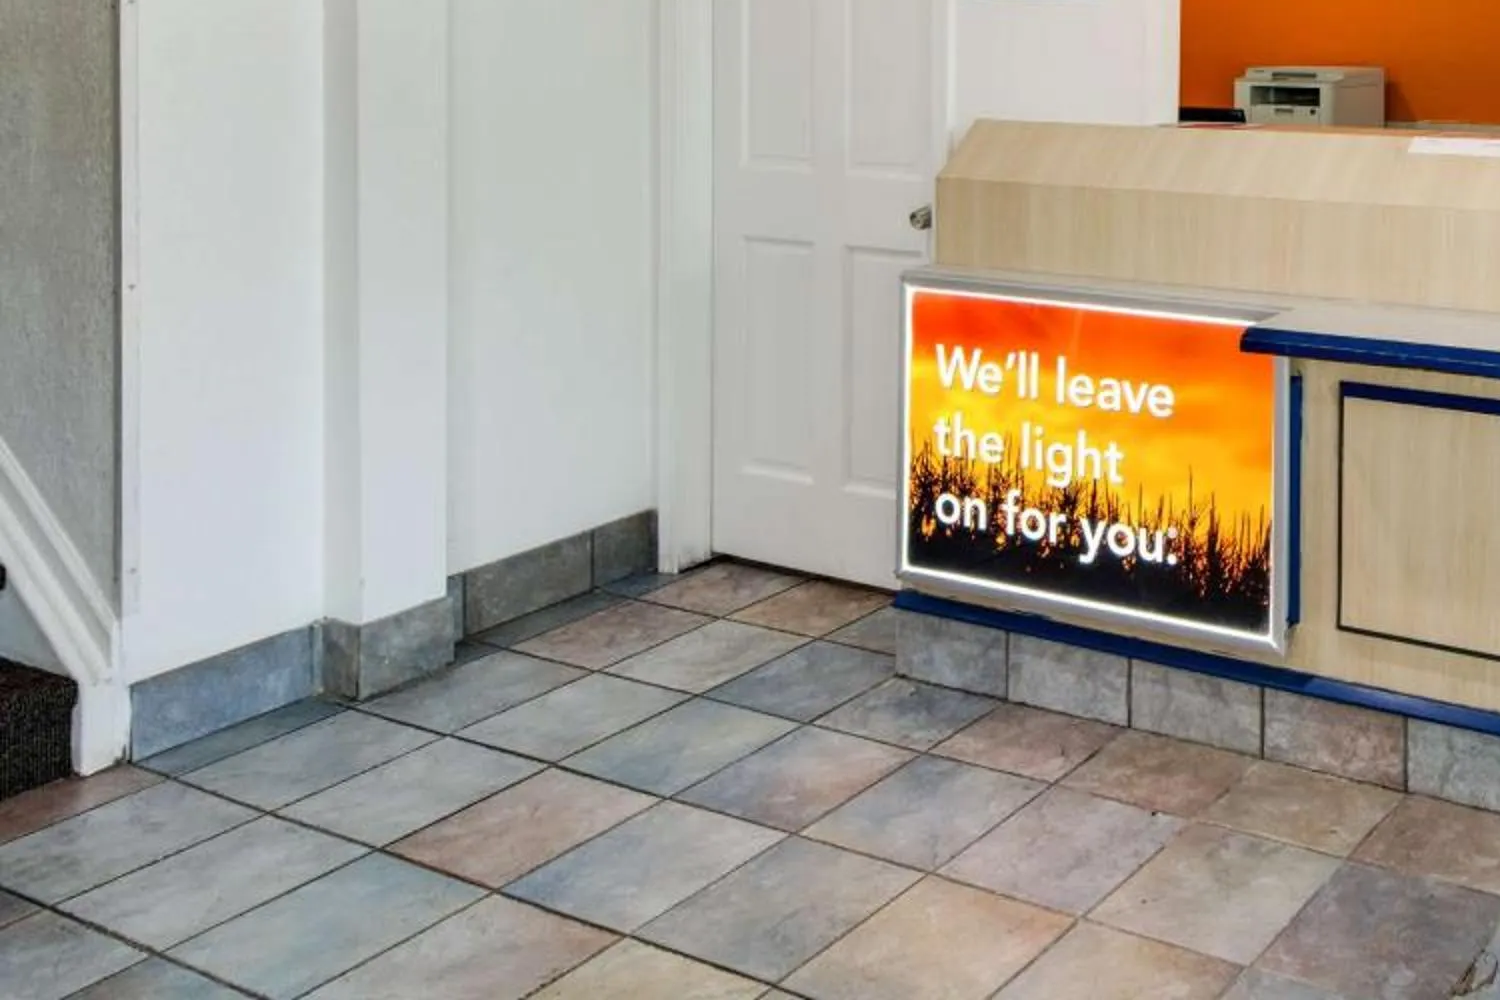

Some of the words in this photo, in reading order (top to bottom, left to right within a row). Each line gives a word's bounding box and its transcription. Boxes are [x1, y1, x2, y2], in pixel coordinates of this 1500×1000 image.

[935, 343, 1040, 399] We'll
[1056, 356, 1175, 418] leave
[934, 411, 1004, 463] the
[1021, 421, 1125, 488] light
[935, 492, 987, 531] on
[1001, 488, 1067, 545] for
